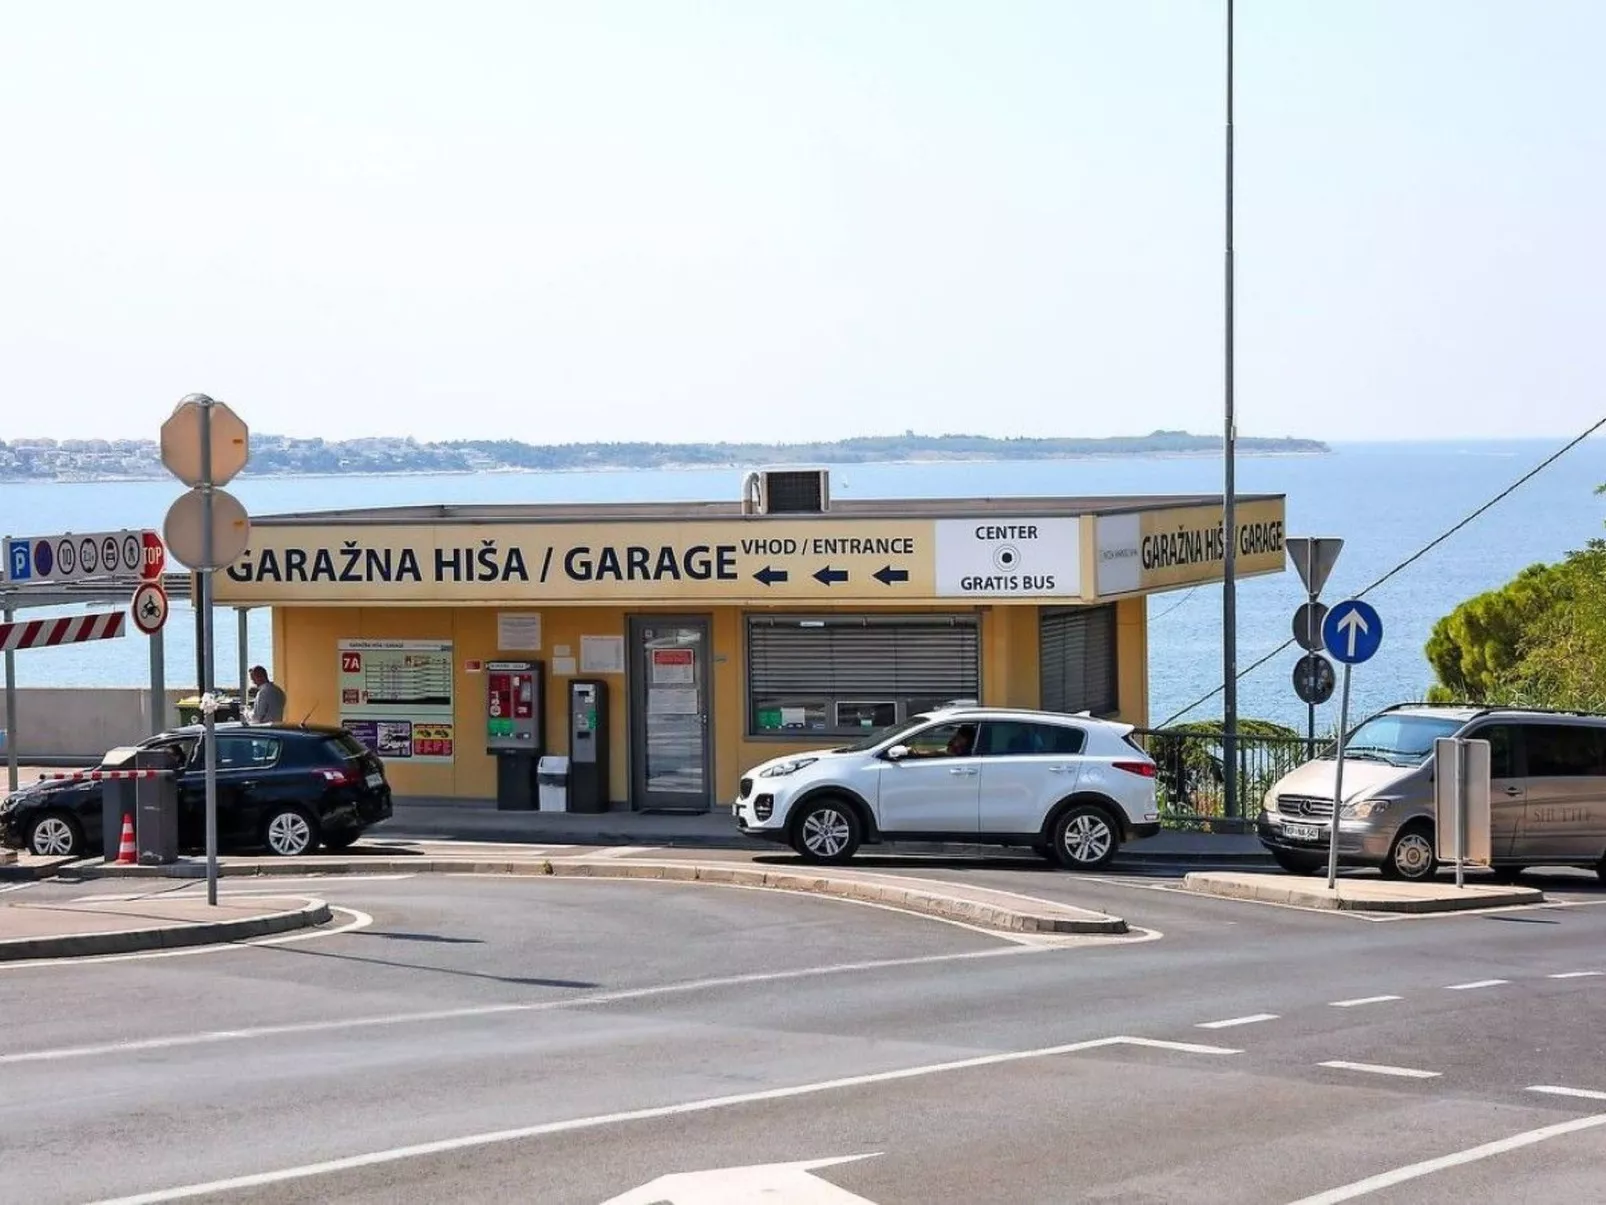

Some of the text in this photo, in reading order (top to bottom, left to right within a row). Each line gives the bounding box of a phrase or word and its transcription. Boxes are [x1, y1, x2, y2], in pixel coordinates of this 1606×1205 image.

[975, 525, 1038, 540] CENTER
[741, 538, 914, 556] VHOD / ENTRANCE
[1142, 524, 1203, 570] GARAŽNA
[1205, 521, 1225, 562] HIŠ
[1240, 521, 1283, 556] GARAGE
[143, 546, 162, 565] TOP
[226, 540, 738, 583] GARAŽNA HIŠA / GARAGE
[960, 575, 1055, 590] GRATIS BUS
[343, 657, 360, 669] 7A
